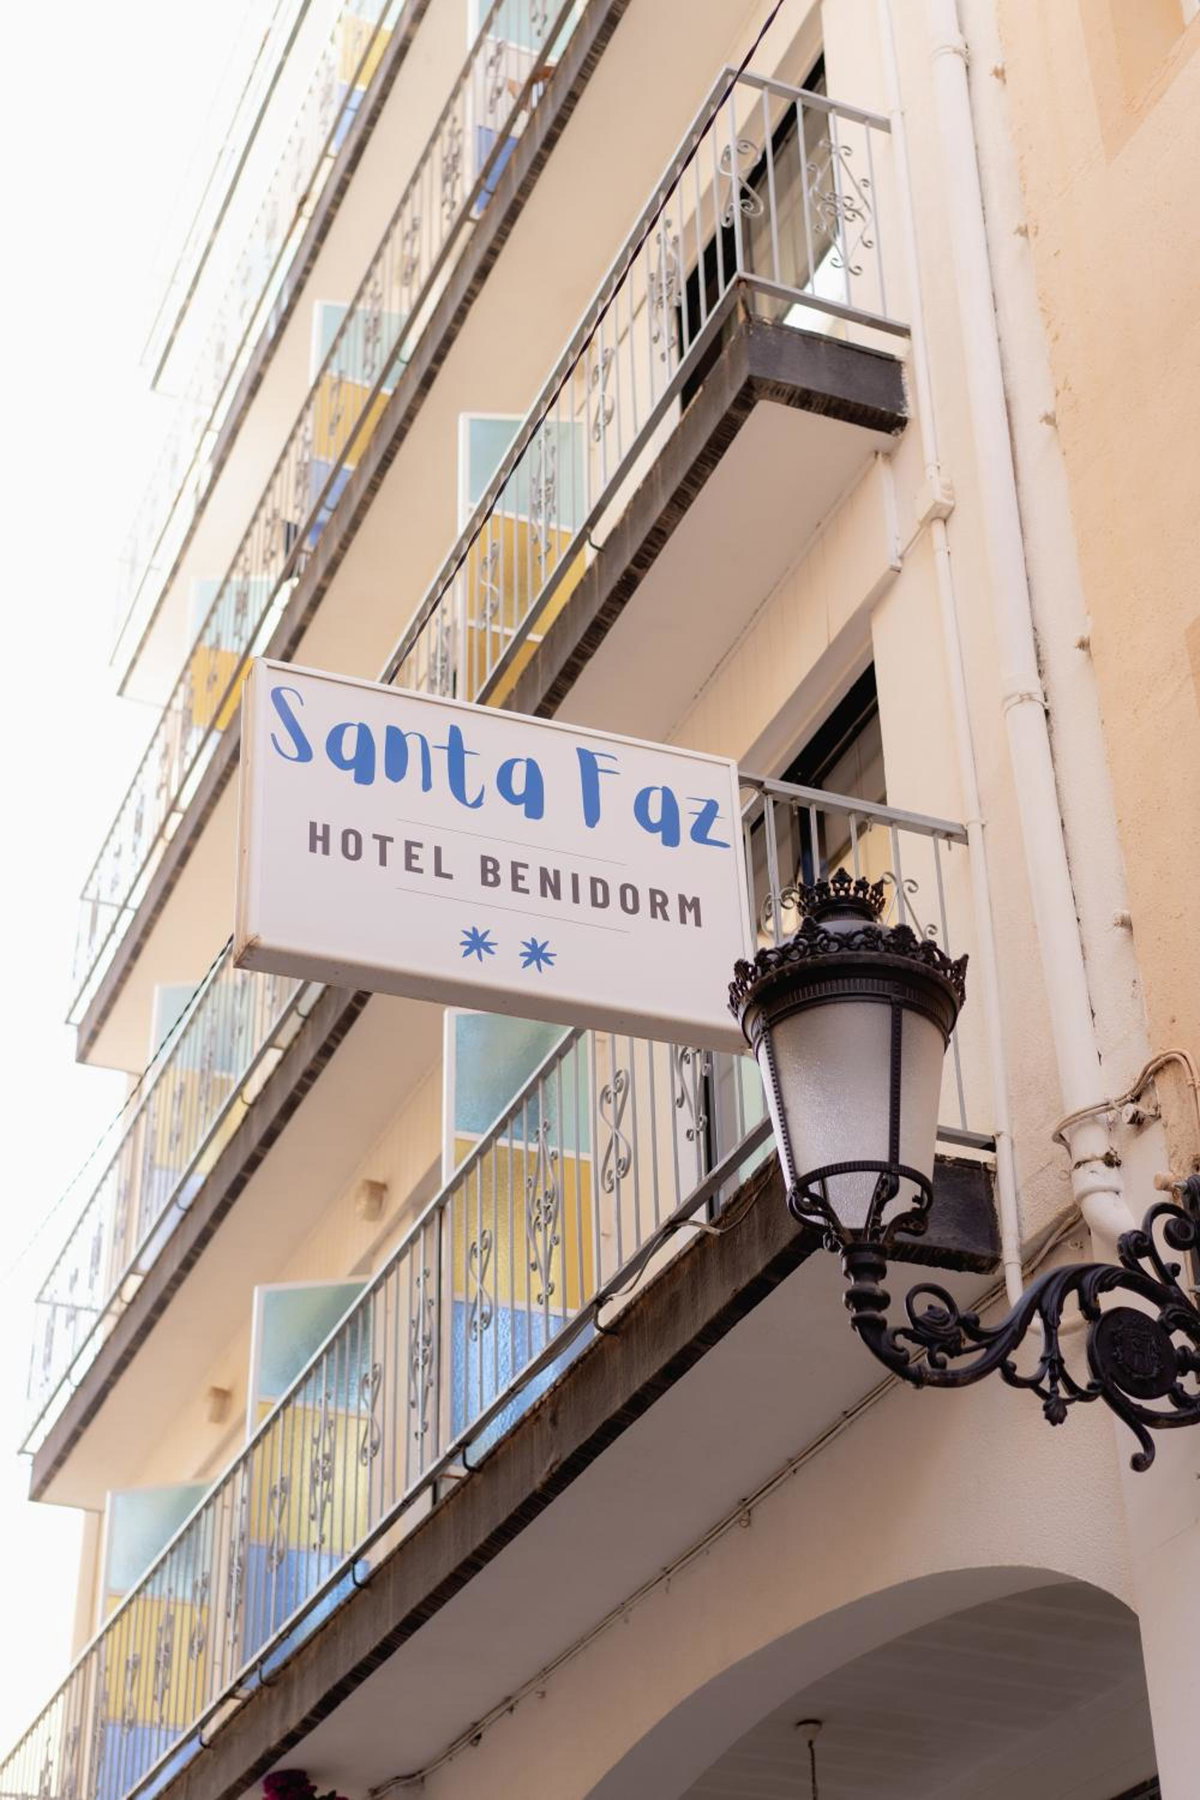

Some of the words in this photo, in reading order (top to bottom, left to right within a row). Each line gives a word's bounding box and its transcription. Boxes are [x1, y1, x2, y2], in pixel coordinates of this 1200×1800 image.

[270, 686, 546, 821] Santa
[575, 747, 732, 849] Faz
[308, 820, 454, 881] HOTEL
[479, 853, 703, 929] BENIDORM
